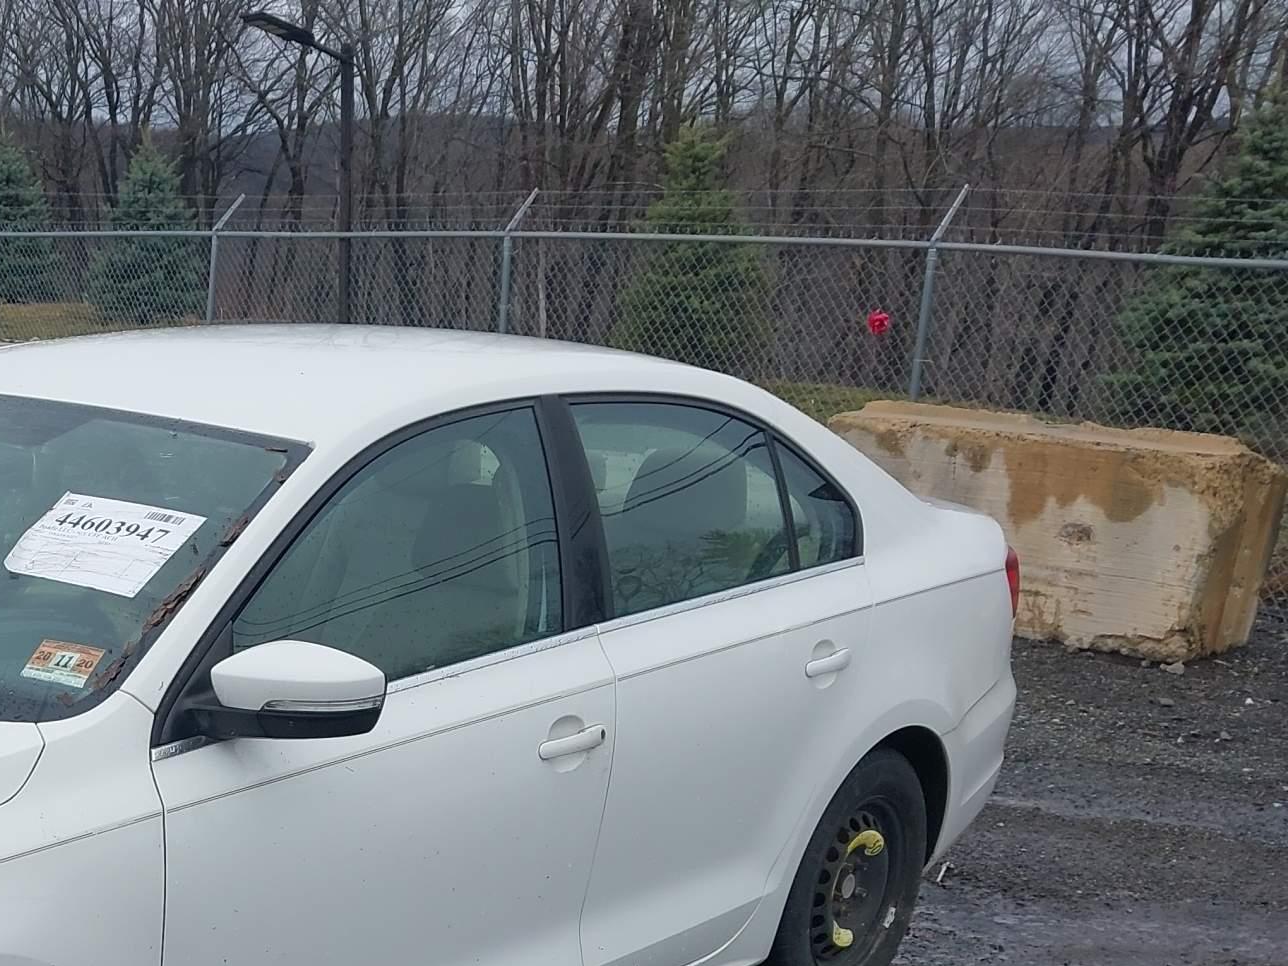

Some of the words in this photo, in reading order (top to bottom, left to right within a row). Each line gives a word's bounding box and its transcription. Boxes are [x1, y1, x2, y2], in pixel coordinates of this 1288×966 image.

[55, 512, 170, 543] 44603947
[35, 650, 52, 661] 20
[53, 654, 74, 668] 11
[76, 659, 94, 669] 20
